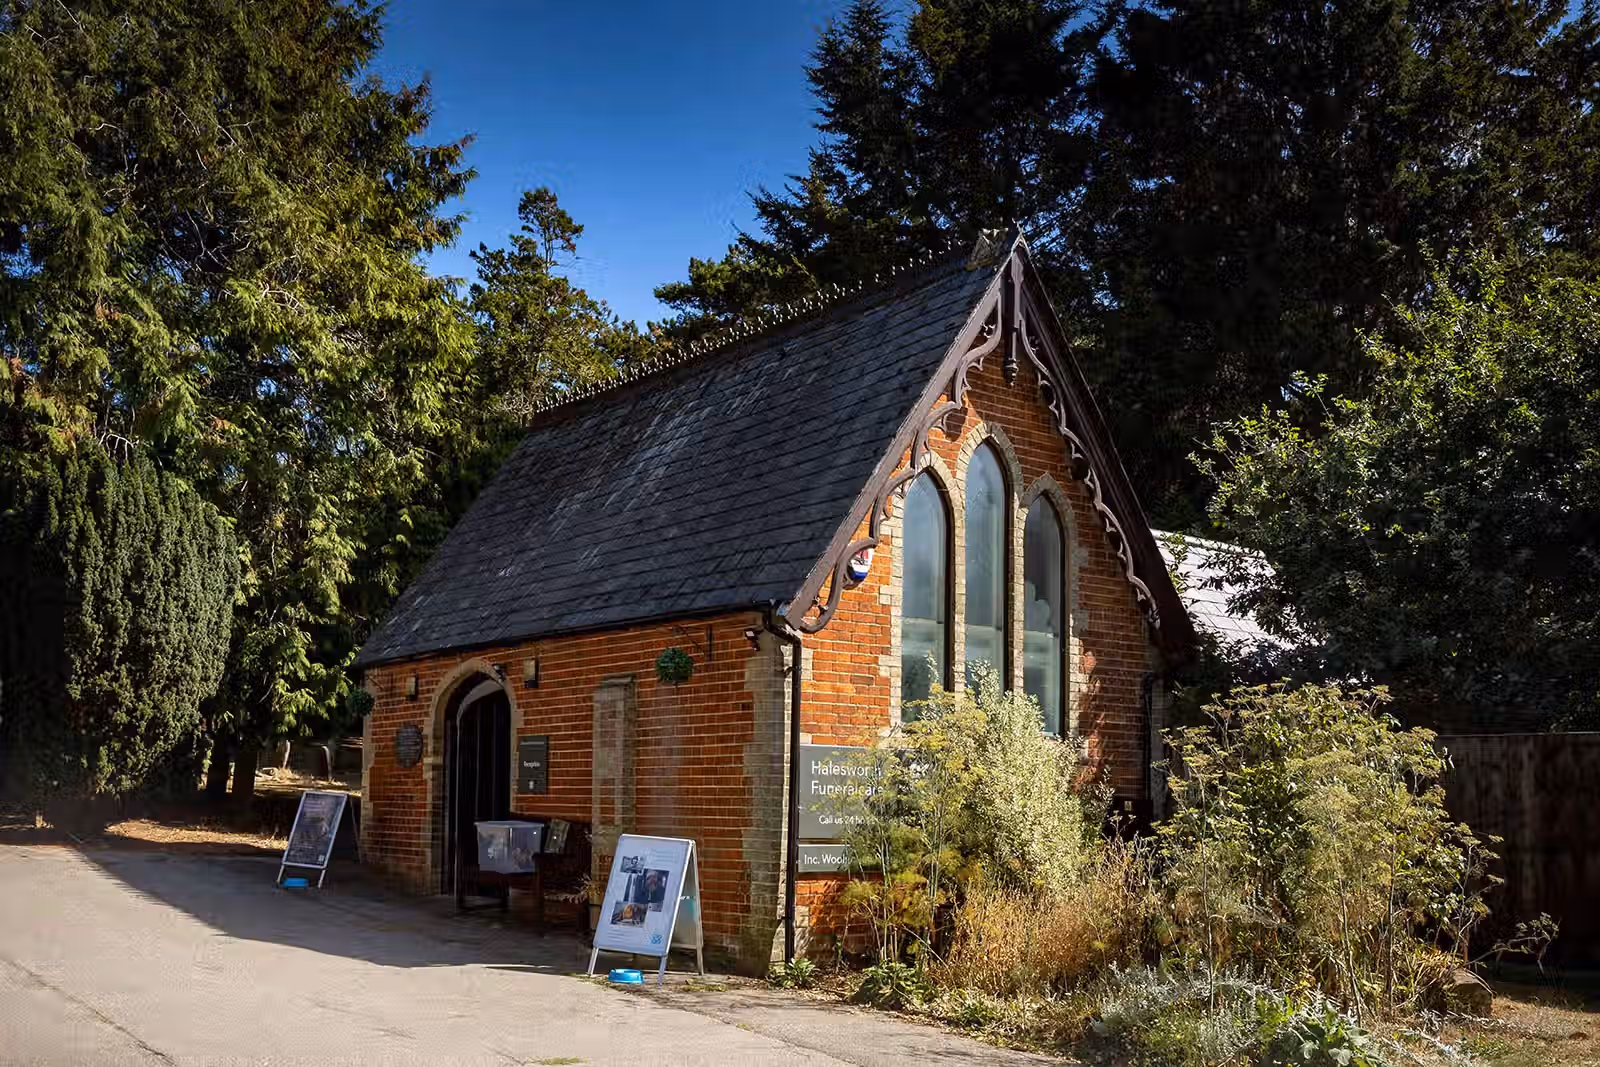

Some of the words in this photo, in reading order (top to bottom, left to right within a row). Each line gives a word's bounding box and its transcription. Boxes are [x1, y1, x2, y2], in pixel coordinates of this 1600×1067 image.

[811, 760, 882, 777] Halesworh
[811, 780, 884, 796] Funeralcare
[818, 815, 833, 825] Call
[834, 816, 843, 825] us
[804, 854, 820, 865] Inc.
